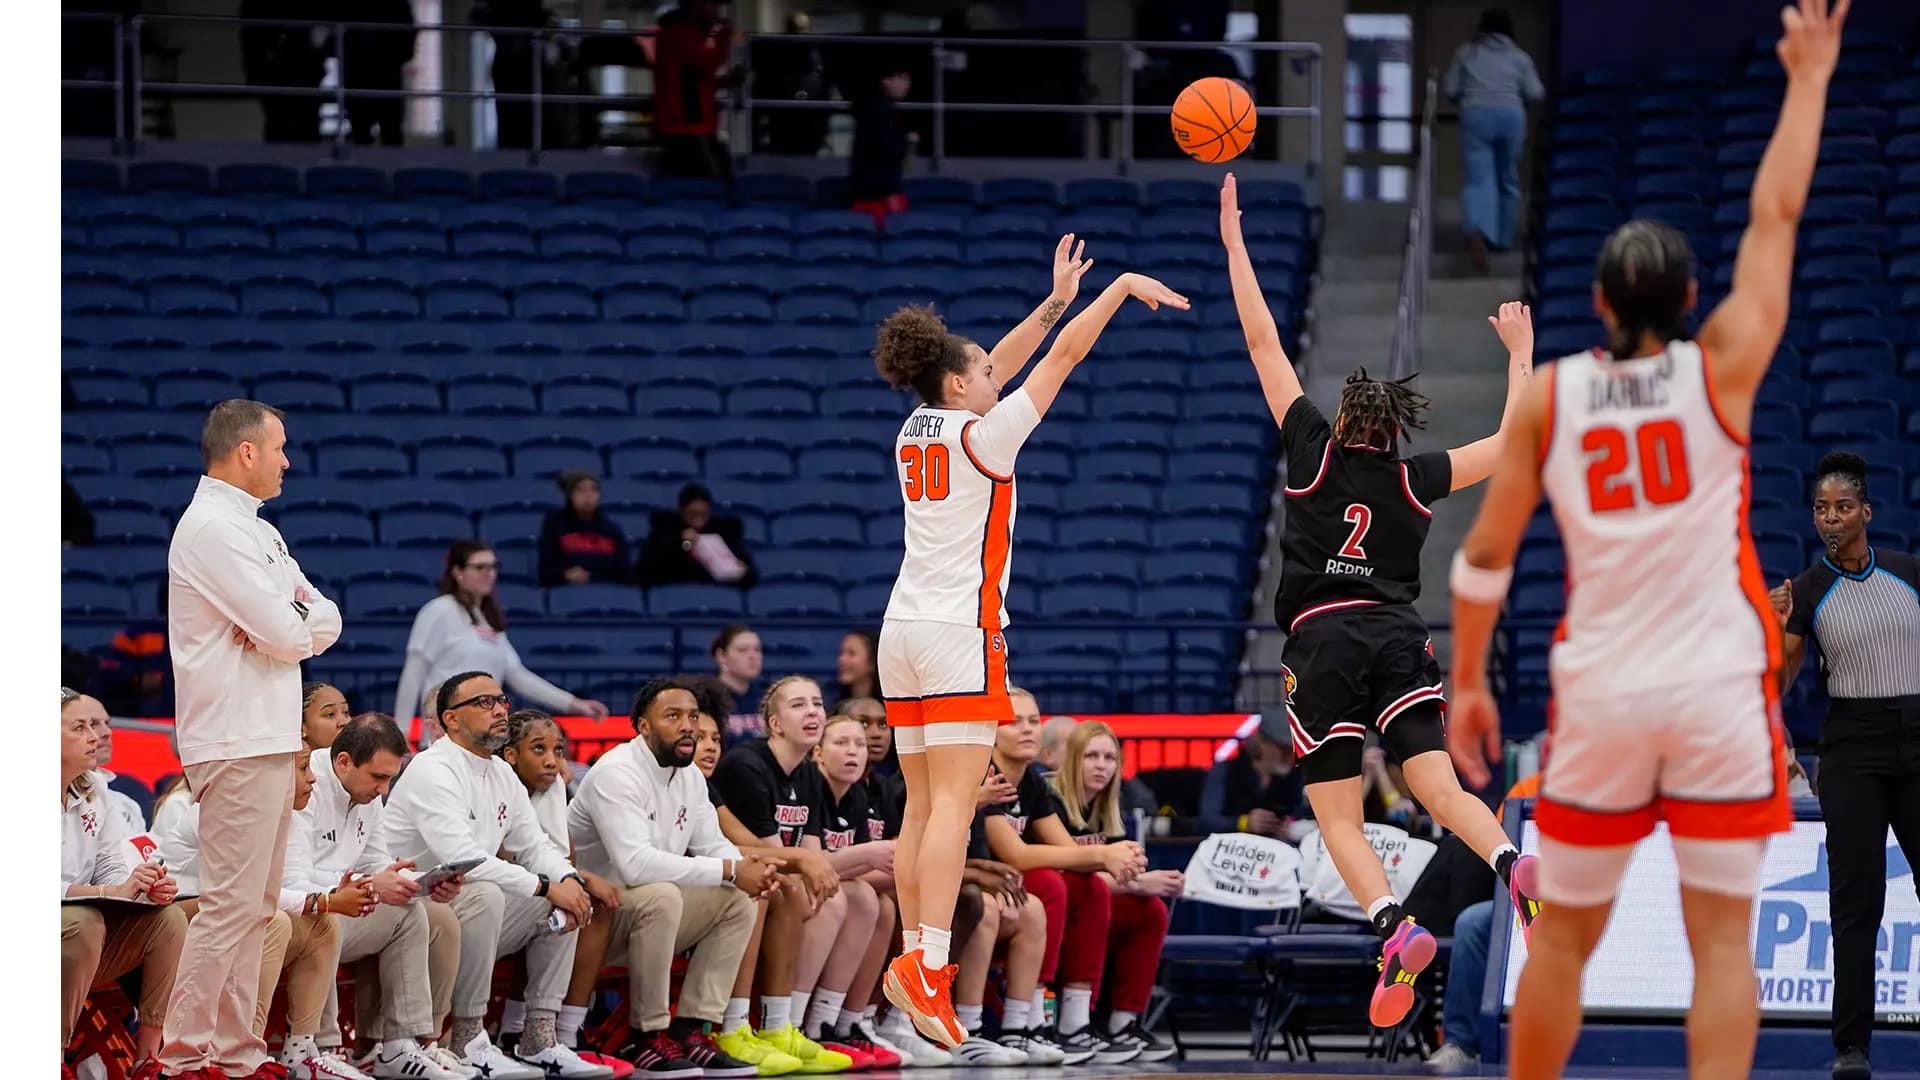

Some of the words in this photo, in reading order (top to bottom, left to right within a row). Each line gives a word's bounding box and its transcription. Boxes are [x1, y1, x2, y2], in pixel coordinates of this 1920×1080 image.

[904, 415, 945, 438] COOPER
[900, 443, 950, 502] 30
[1581, 418, 1692, 515] 20
[1337, 503, 1372, 560] 2
[1217, 839, 1276, 864] Hidden
[1211, 855, 1257, 876] Level
[1757, 977, 1907, 1004] MORTGE
